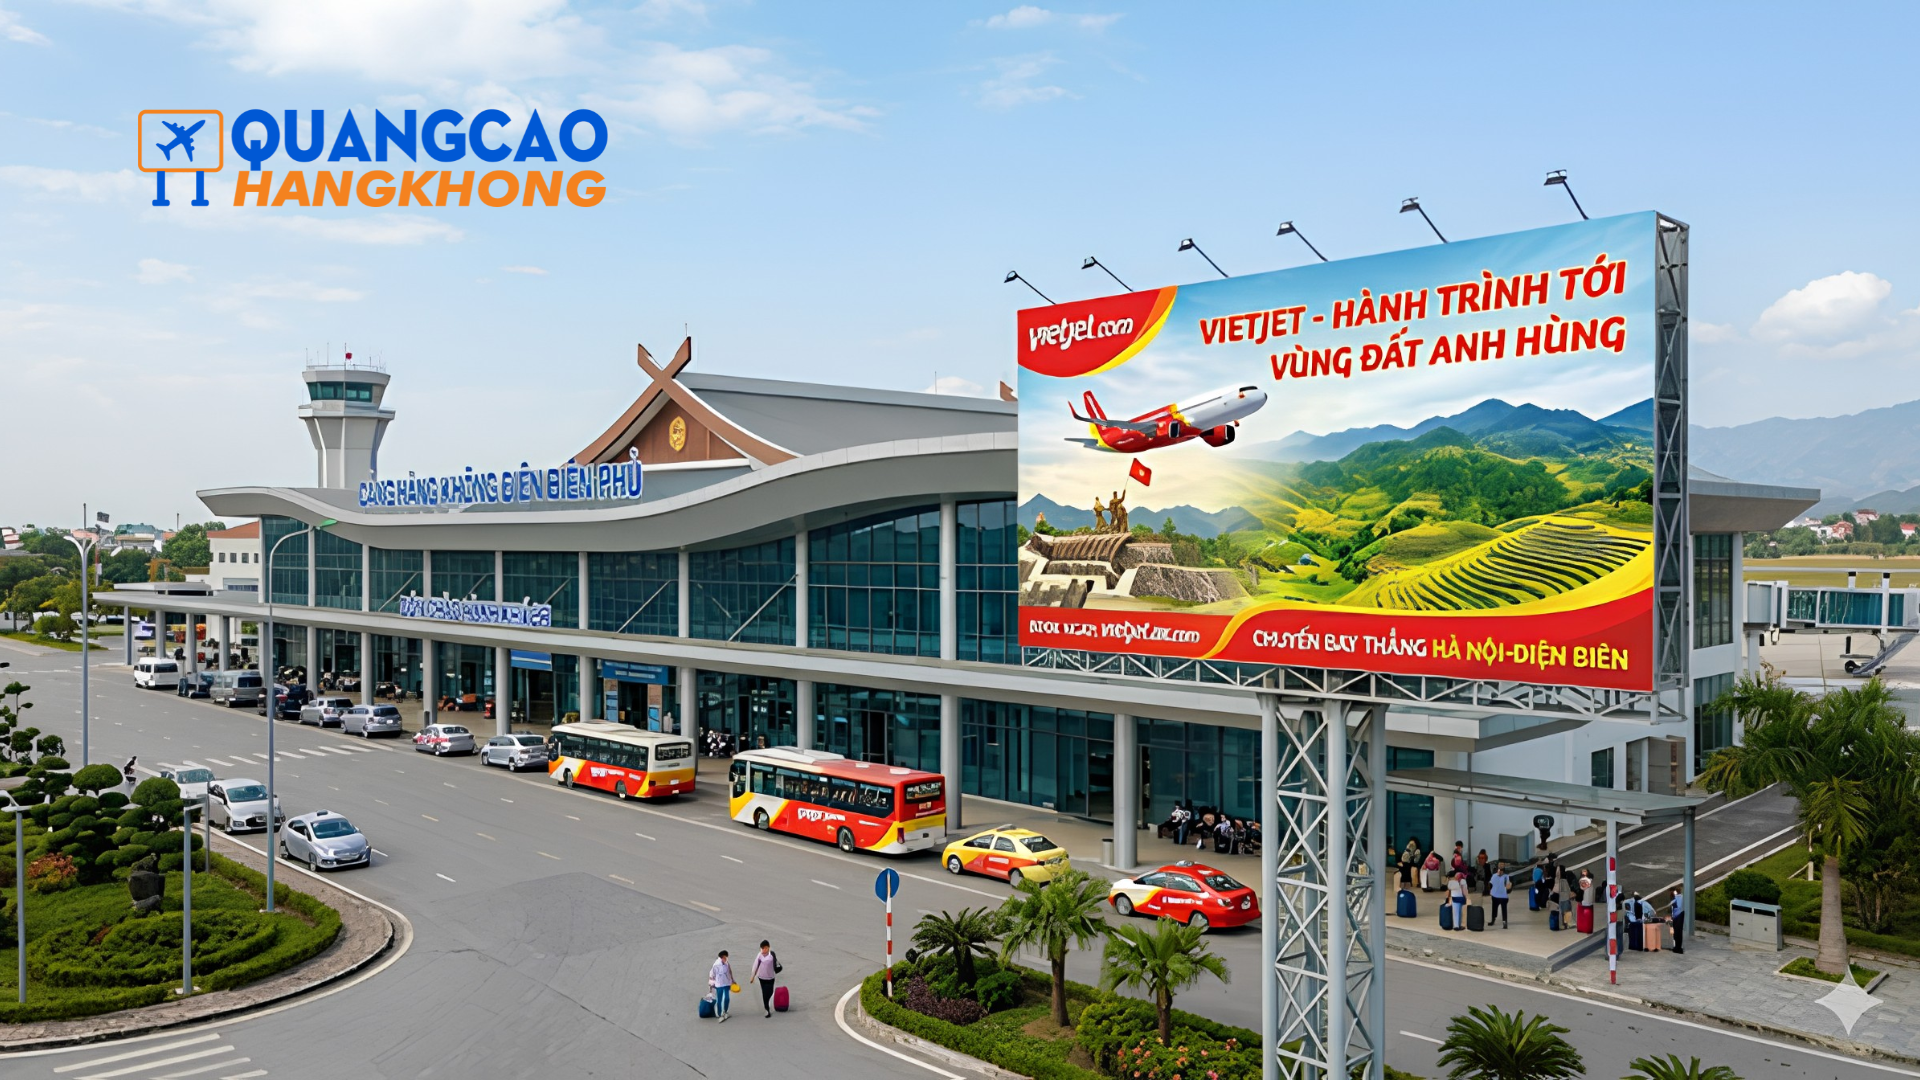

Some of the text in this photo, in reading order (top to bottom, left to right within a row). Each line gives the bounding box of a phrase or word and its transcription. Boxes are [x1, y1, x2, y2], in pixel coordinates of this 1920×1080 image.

[1199, 305, 1307, 345] VIETJET
[1332, 288, 1428, 329] HÀNH
[1436, 270, 1549, 316] TRÌNH
[1559, 253, 1626, 301] TỚI
[1270, 313, 1625, 381] VÙNG ĐẤT ANH HÙNG
[1432, 634, 1461, 660] HÀ
[1573, 643, 1629, 671] BIÊN
